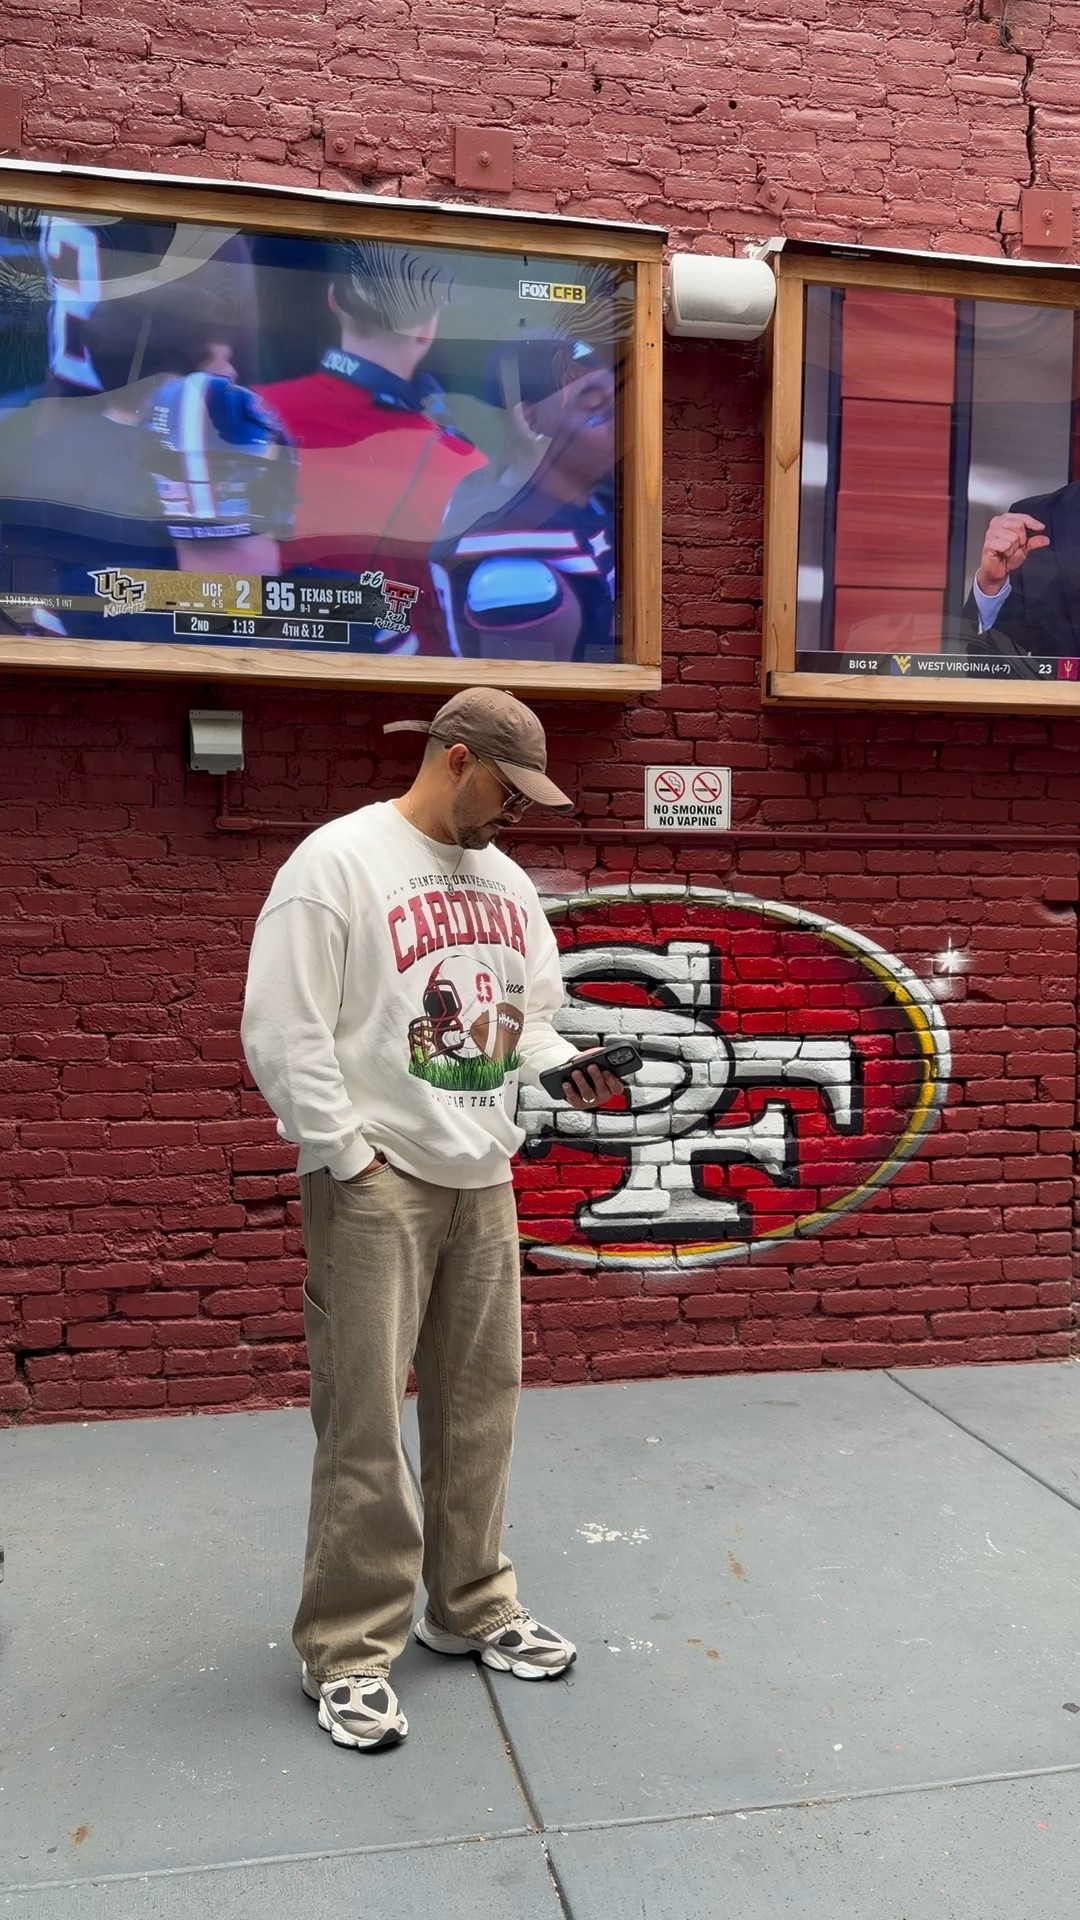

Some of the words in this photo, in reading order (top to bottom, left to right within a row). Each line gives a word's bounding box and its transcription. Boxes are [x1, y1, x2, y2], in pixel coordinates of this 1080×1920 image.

[521, 283, 549, 298] FOX
[553, 286, 583, 301] CFB
[361, 571, 384, 587] #6
[98, 570, 144, 604] UCF
[202, 582, 223, 597] UCF
[235, 580, 251, 608] 2
[56, 598, 60, 607] 1
[61, 599, 72, 608] INT
[211, 599, 224, 608] 4-5
[265, 582, 295, 611] 35
[300, 588, 333, 603] TEXAS
[336, 590, 362, 604] TECH
[103, 601, 146, 617] KNIGHTS
[300, 604, 311, 613] 9-1
[385, 611, 403, 622] RED
[190, 616, 210, 632] 2ND
[232, 619, 256, 635] 1:13
[281, 622, 300, 637] 4TH
[301, 623, 310, 638] &
[311, 624, 325, 639] 12
[373, 617, 411, 633] RAIDERS
[849, 659, 867, 669] BIG
[868, 660, 878, 670] 12
[917, 660, 945, 671] WEST
[946, 662, 990, 673] VIRGINIA
[991, 664, 1011, 674] (4-7)
[1038, 664, 1052, 674] 23
[653, 805, 669, 815] NO
[671, 805, 723, 816] SMOKING
[659, 816, 675, 827] NO
[677, 816, 717, 827] VAPING
[452, 874, 507, 894] UNIVERSITY
[388, 890, 528, 974] CARDINA
[505, 979, 525, 994] ince
[471, 1095, 496, 1107] THE
